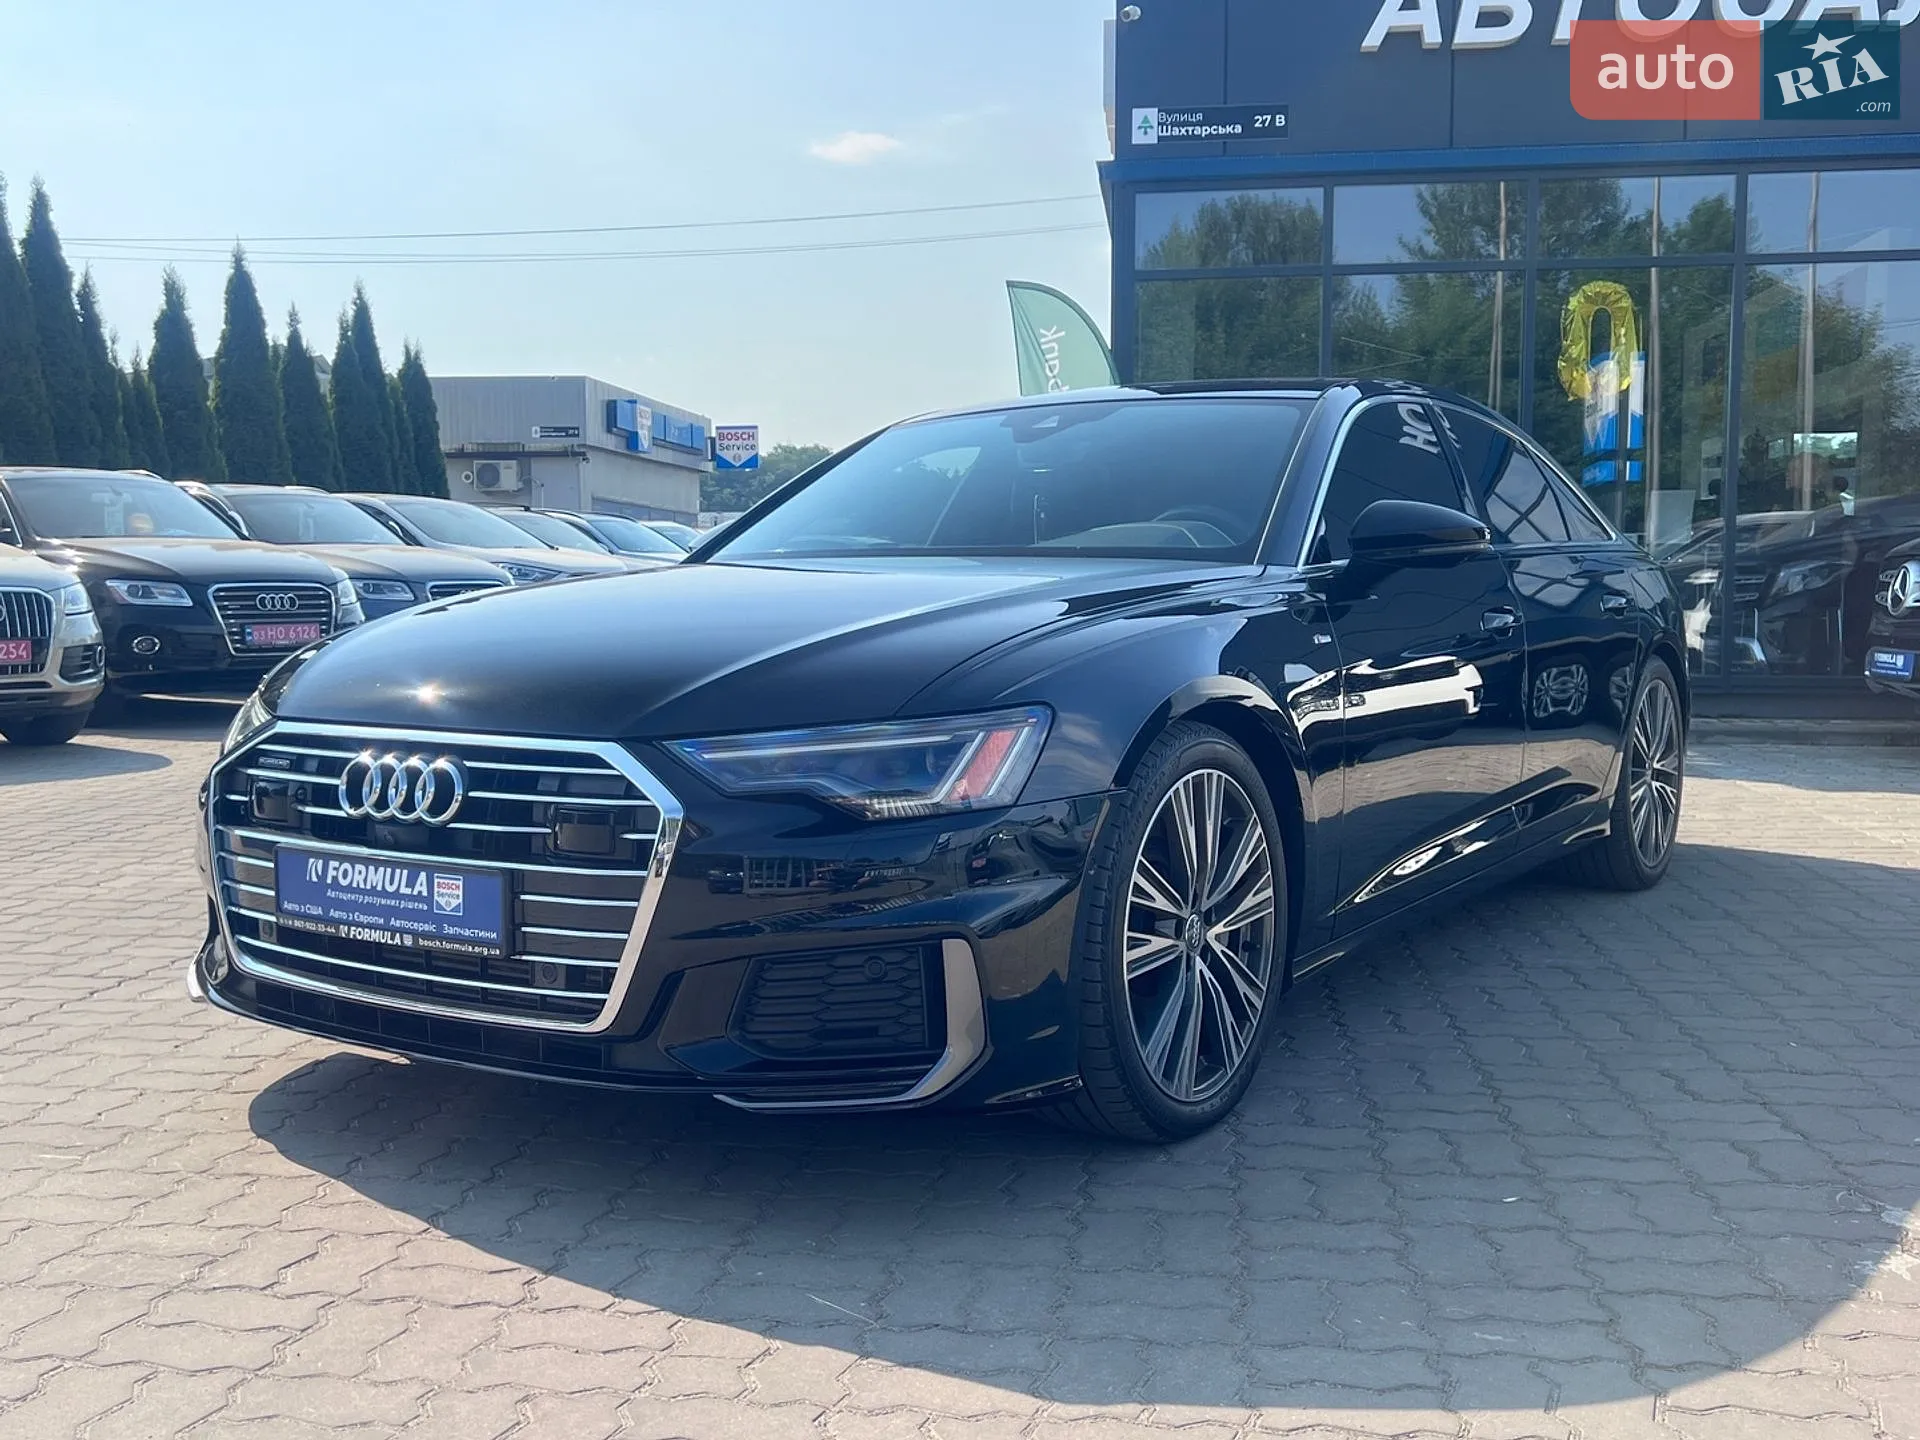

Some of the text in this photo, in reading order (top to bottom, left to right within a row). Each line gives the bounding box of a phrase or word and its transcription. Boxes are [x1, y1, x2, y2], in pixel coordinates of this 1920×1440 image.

[1158, 111, 1204, 124] Вулиця
[1253, 114, 1272, 128] 27
[1158, 123, 1244, 138] Шахтарська
[718, 431, 756, 442] BOSCH
[718, 442, 757, 452] Service
[326, 860, 429, 897] FORMULA
[435, 880, 461, 892] BOSCH
[435, 890, 461, 901] Service
[282, 900, 300, 912] Авто
[328, 908, 347, 920] Авто
[389, 917, 437, 933] Автосервіс
[442, 923, 498, 940] Запчастини
[350, 926, 402, 946] FORMULA
[418, 936, 500, 956] bosch.formula.org.ua
